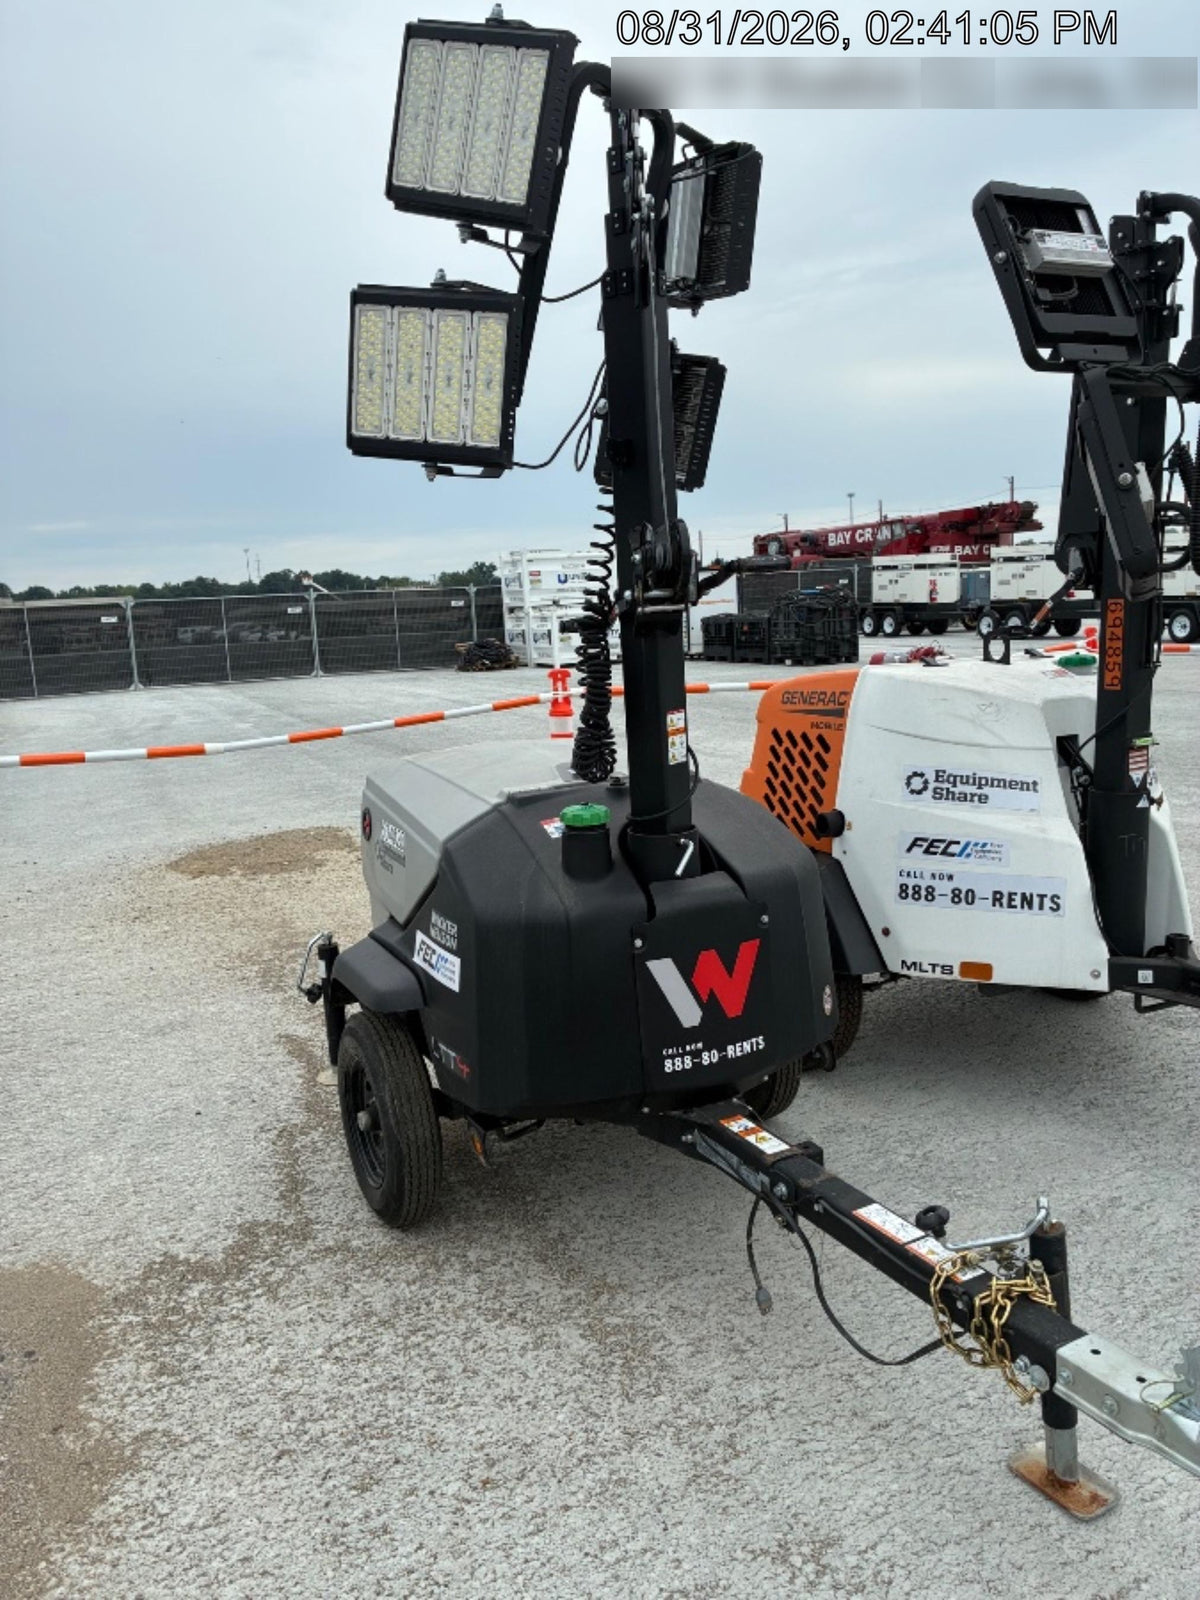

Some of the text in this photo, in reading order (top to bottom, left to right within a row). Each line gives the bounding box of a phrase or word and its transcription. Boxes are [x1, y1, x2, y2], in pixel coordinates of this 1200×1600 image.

[828, 526, 892, 546] BAY CRAN
[954, 545, 982, 555] BAY
[1106, 602, 1122, 688] 694859
[782, 691, 850, 706] GENERAC
[933, 769, 1039, 793] Equipment
[932, 787, 989, 804] Share
[905, 837, 961, 858] FEC
[899, 869, 954, 881] CALL NOW
[898, 883, 1062, 912] 888-80-RENTS
[664, 1035, 765, 1073] 888-80-RENTS
